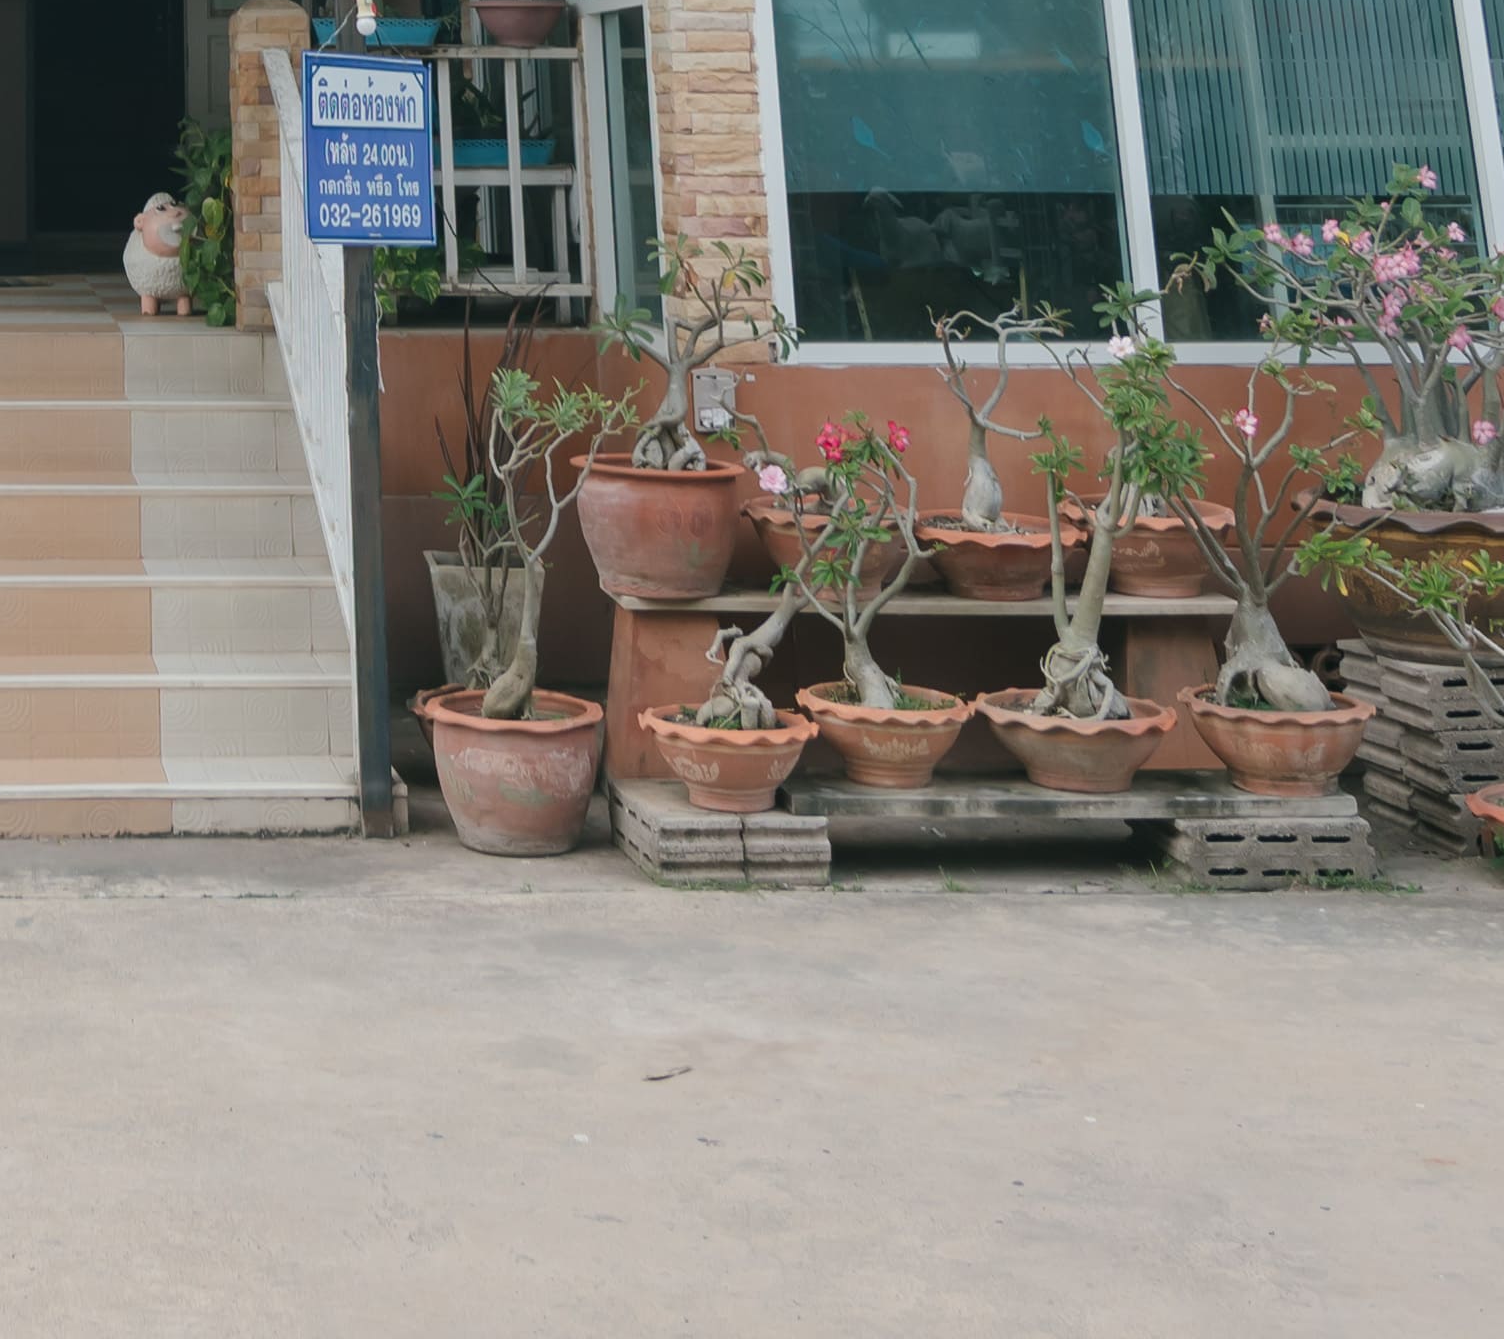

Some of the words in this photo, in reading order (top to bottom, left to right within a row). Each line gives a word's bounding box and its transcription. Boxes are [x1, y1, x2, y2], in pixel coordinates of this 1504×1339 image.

[318, 76, 417, 123] ติดต่อห้องพัก
[324, 132, 357, 166] (หลัง
[319, 169, 360, 196] กดกริ่ง
[366, 173, 393, 197] หรือ
[319, 202, 422, 228] 032-261969
